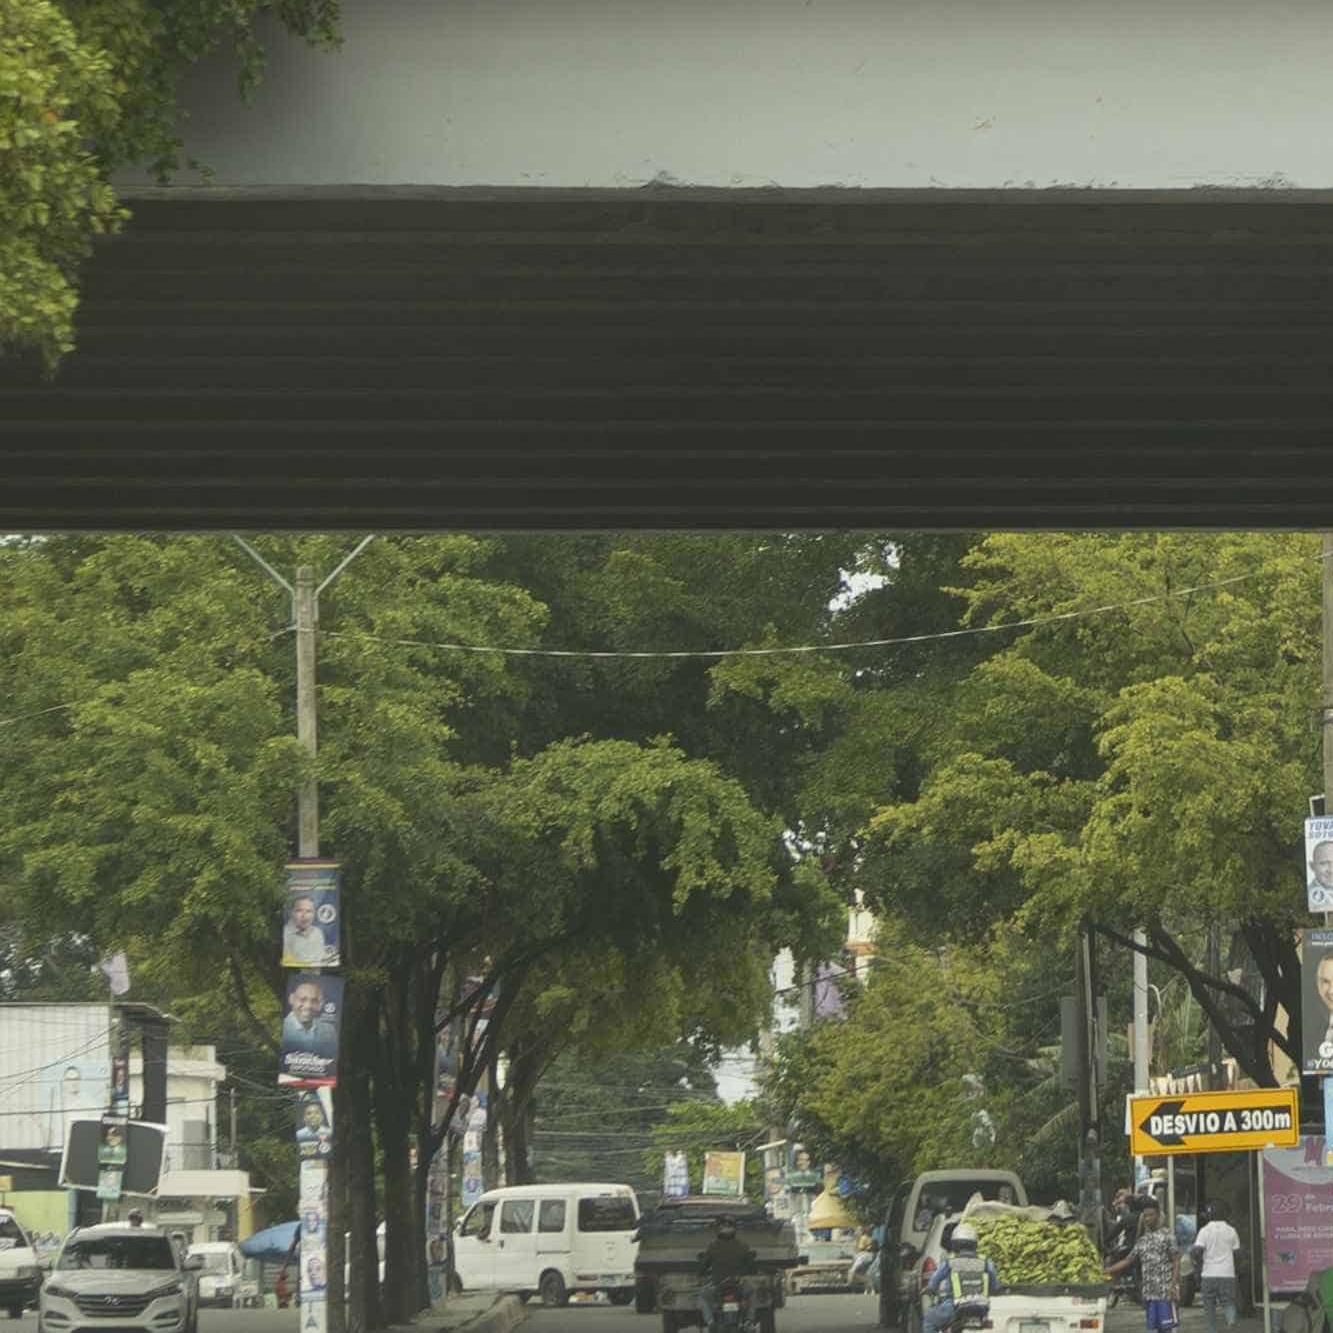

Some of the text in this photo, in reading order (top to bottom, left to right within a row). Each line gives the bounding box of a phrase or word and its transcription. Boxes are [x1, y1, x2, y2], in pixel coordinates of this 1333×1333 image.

[1150, 1109, 1291, 1136] DESVIO A 300m
